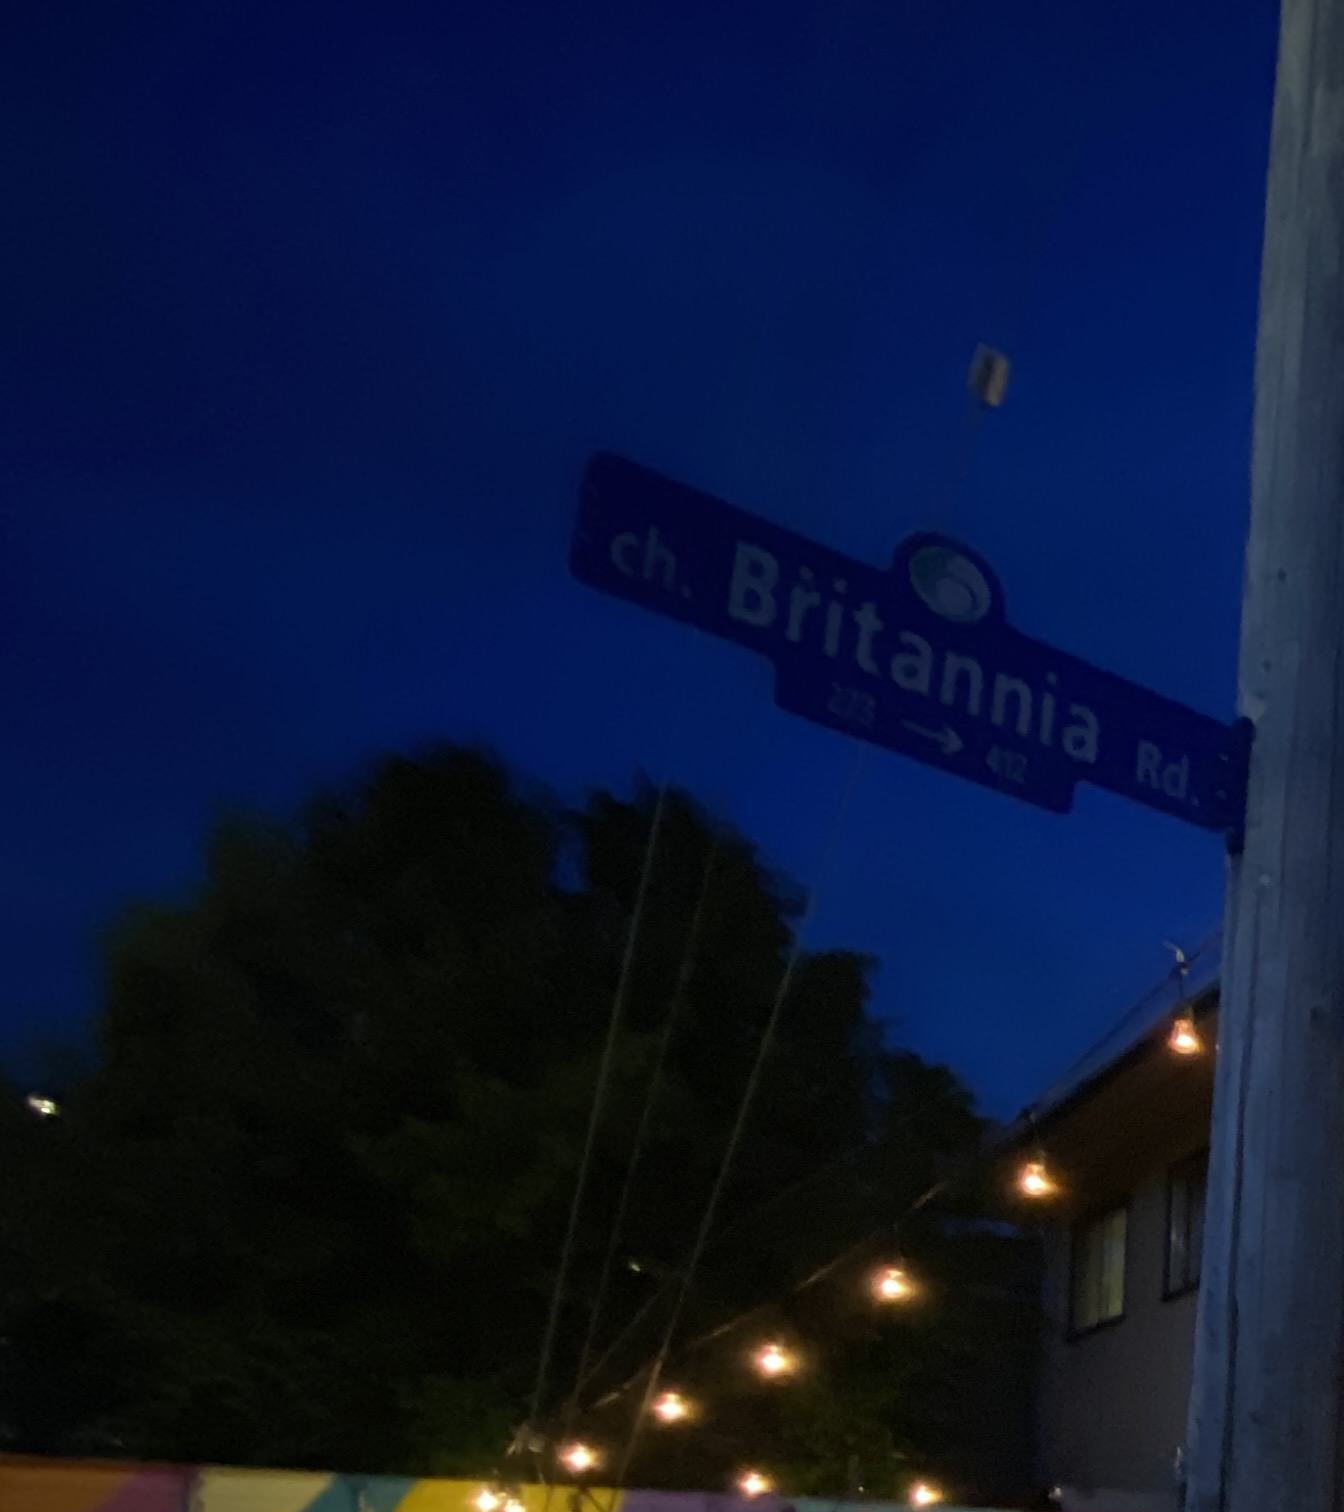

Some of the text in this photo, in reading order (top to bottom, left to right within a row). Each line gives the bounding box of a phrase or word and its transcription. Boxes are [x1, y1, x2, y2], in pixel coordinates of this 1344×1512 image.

[608, 523, 1200, 806] ch. Britannia Rd.
